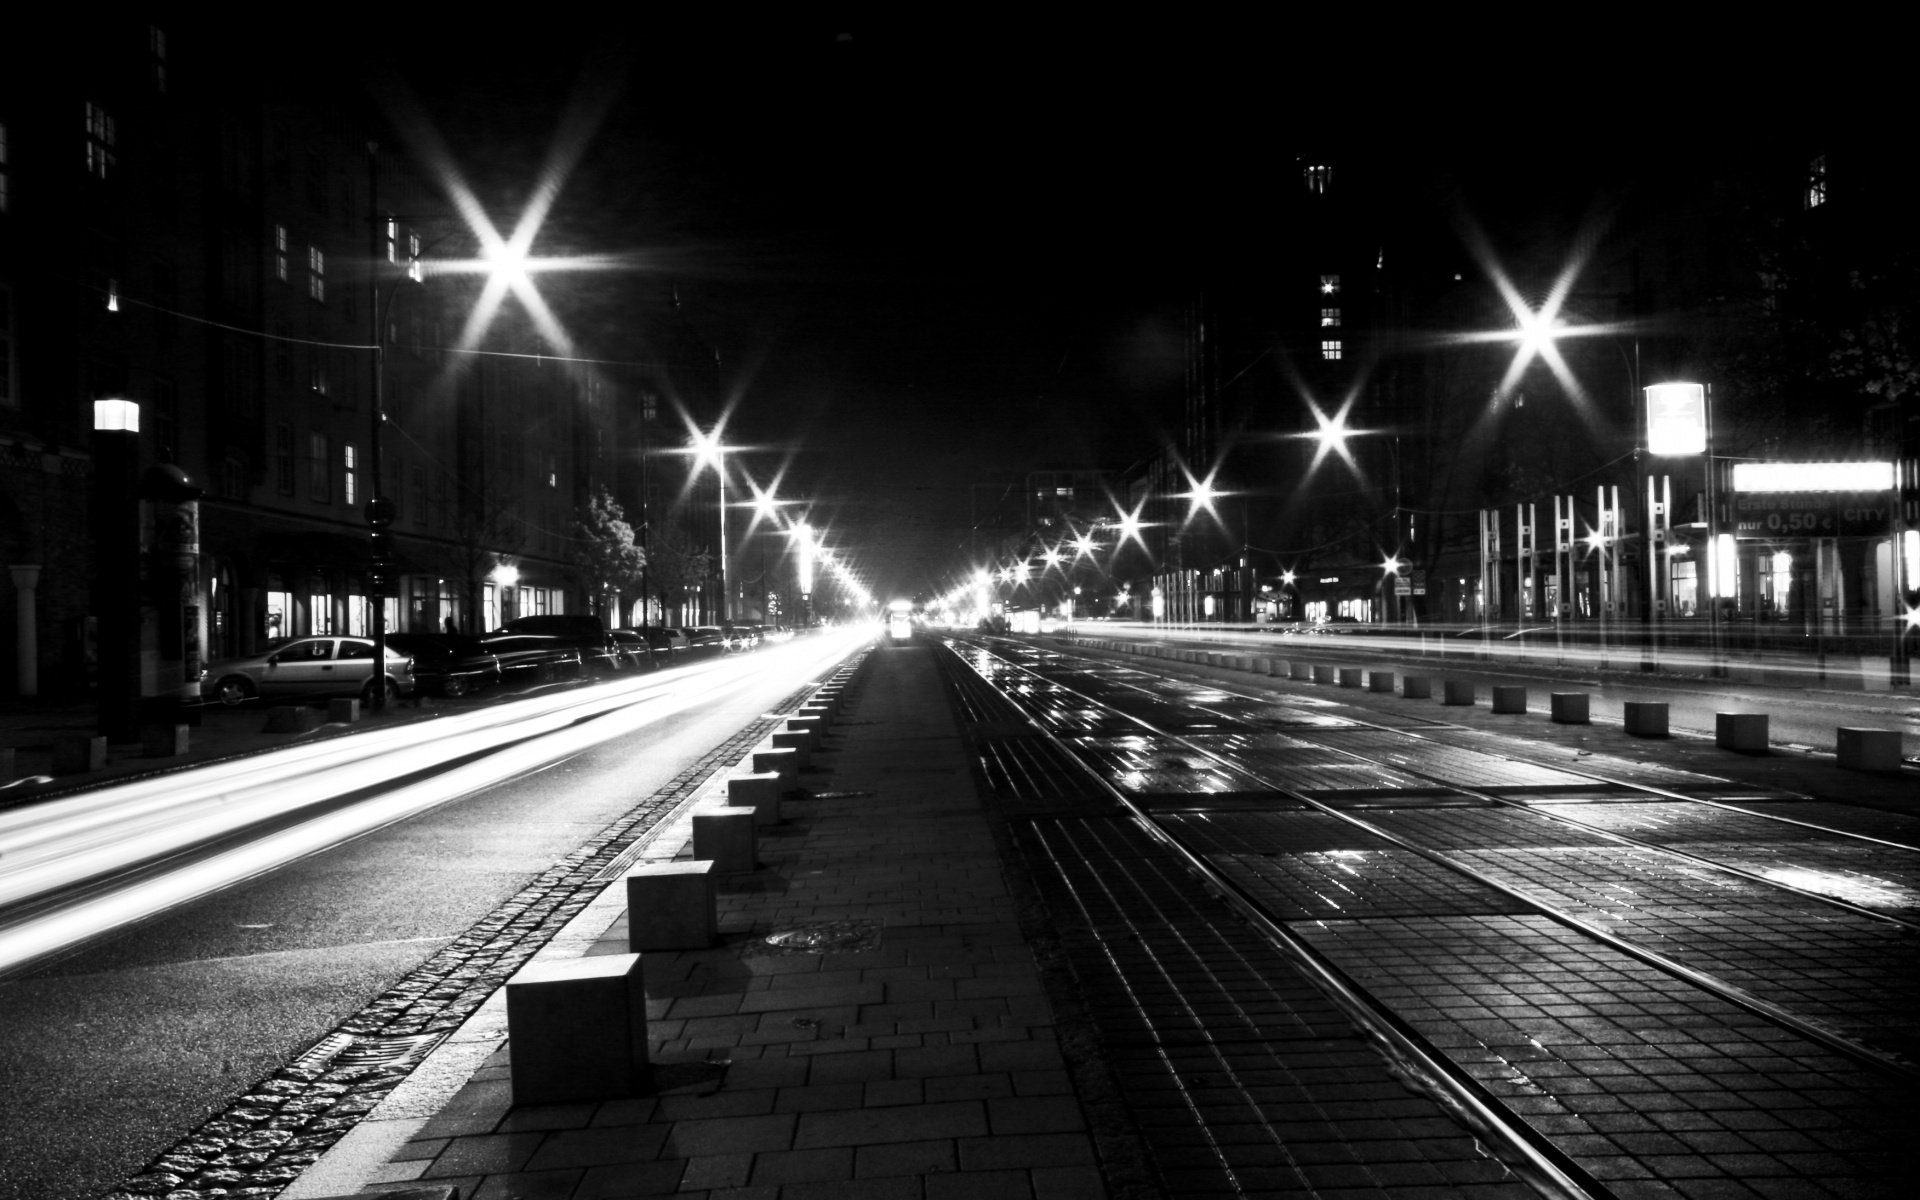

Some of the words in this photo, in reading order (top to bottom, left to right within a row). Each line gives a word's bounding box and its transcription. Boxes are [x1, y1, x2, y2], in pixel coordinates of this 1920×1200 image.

[1738, 499, 1776, 510] Erste
[1780, 498, 1831, 510] Stunde
[1844, 508, 1885, 521] CITY
[1738, 521, 1763, 531] nur
[1767, 513, 1817, 534] 0,50
